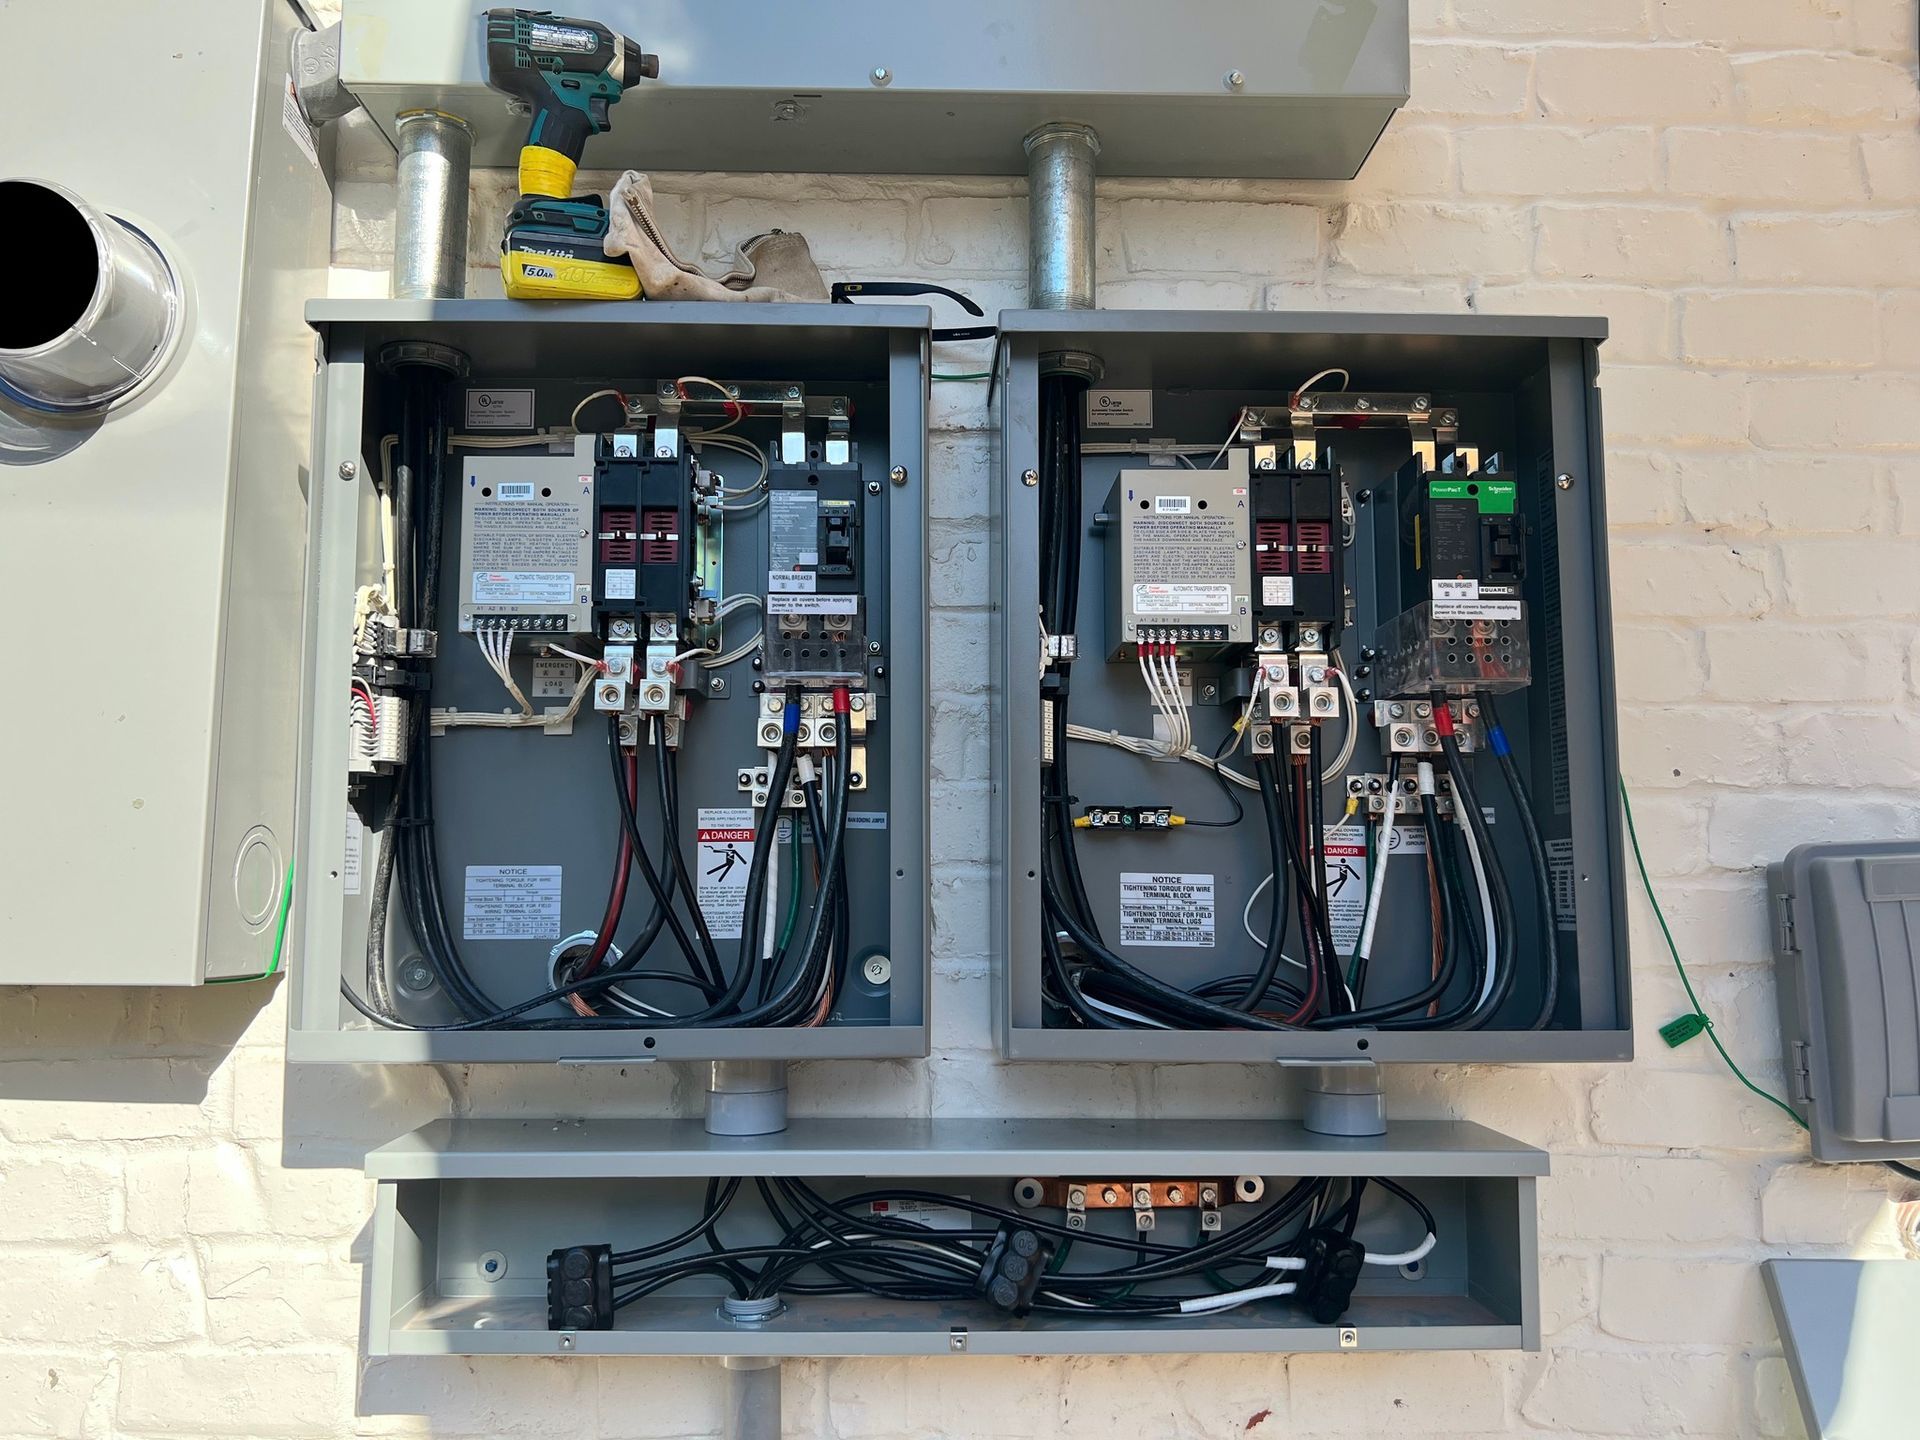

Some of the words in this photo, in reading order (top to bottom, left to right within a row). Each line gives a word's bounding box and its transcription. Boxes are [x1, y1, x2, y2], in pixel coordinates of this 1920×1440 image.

[526, 266, 553, 279] 5.0Ah
[582, 486, 590, 495] A
[1488, 486, 1512, 494] Schneider
